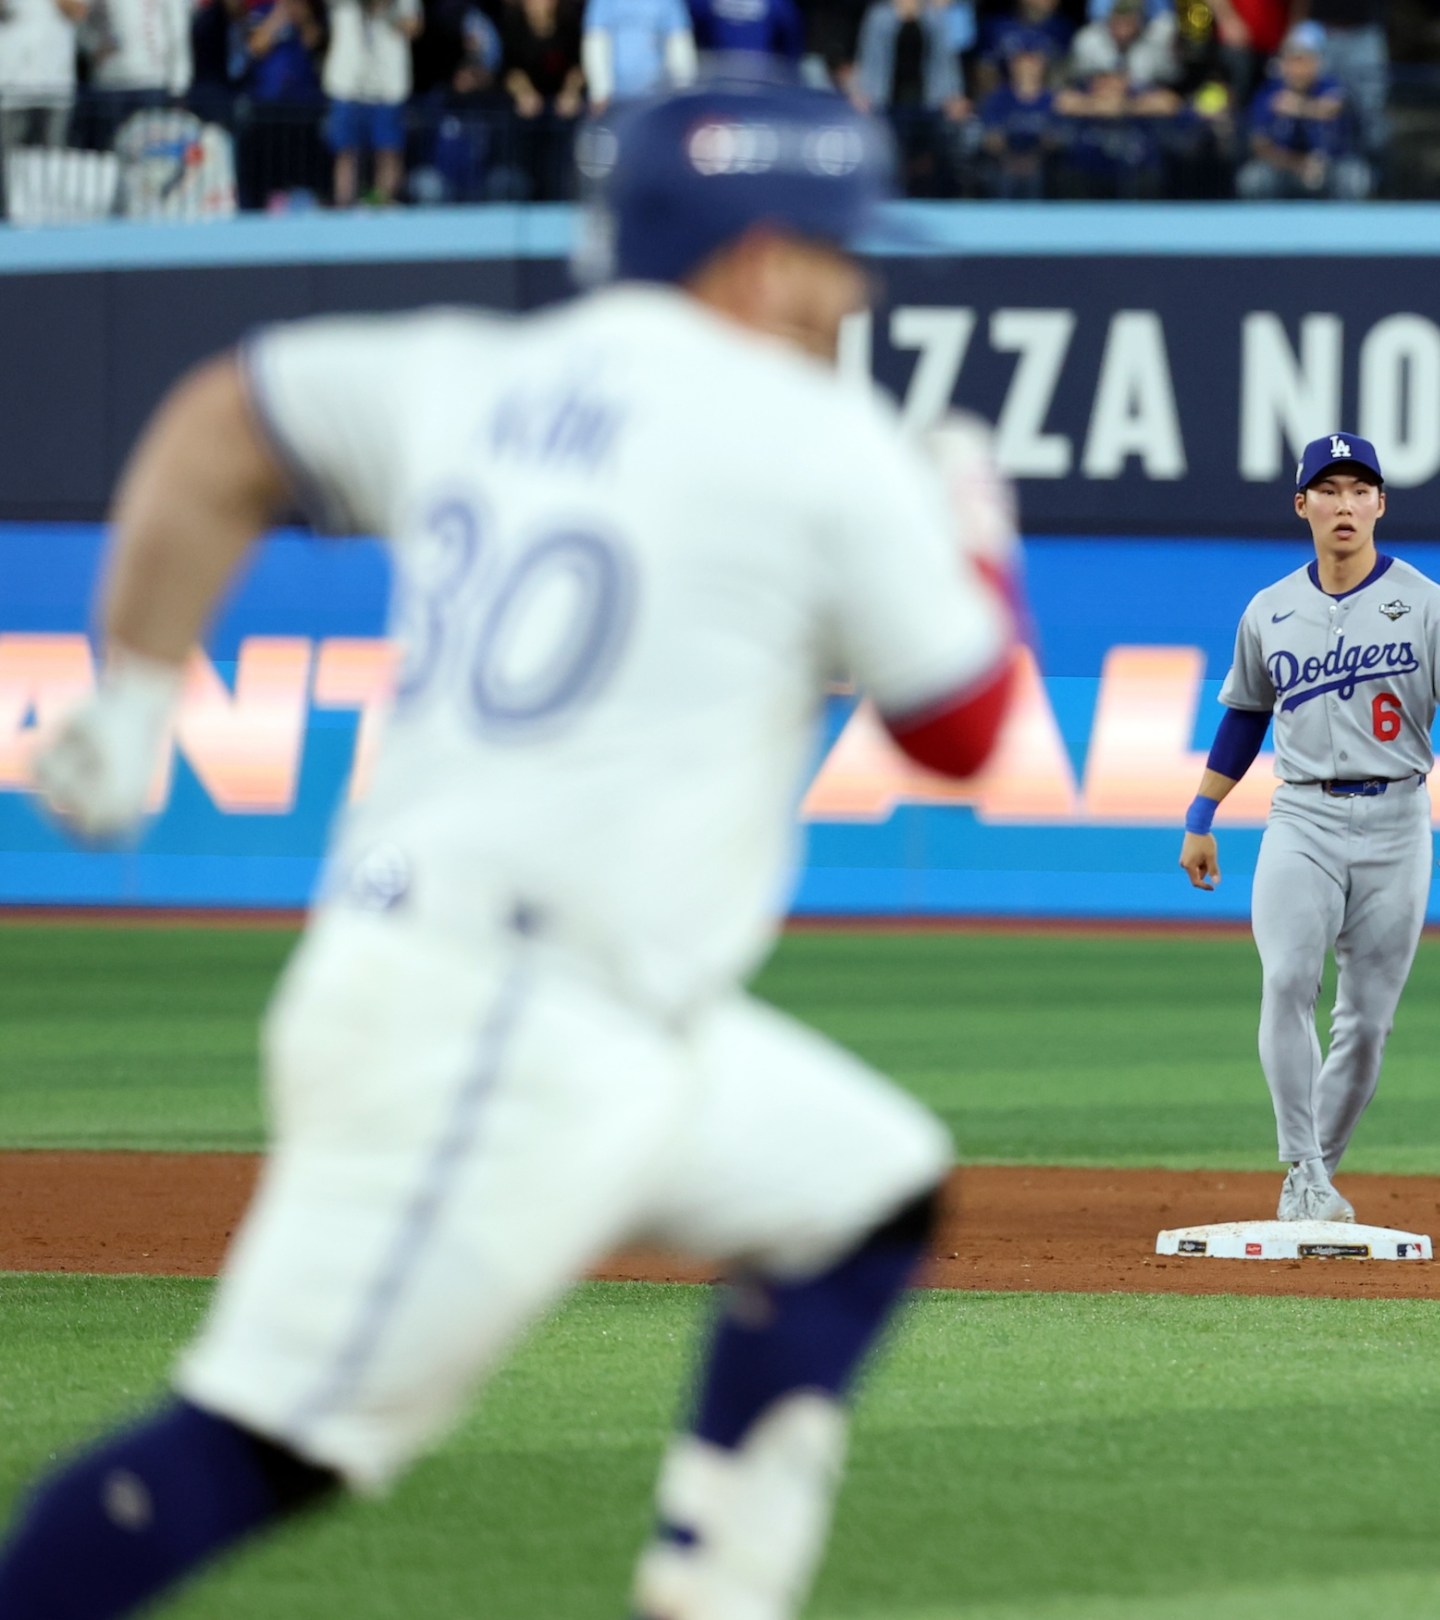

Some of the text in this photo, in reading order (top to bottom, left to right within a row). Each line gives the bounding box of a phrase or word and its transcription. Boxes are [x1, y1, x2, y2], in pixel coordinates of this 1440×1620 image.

[1329, 435, 1352, 458] LA
[1267, 635, 1419, 702] Dodgers
[1371, 692, 1402, 742] 6
